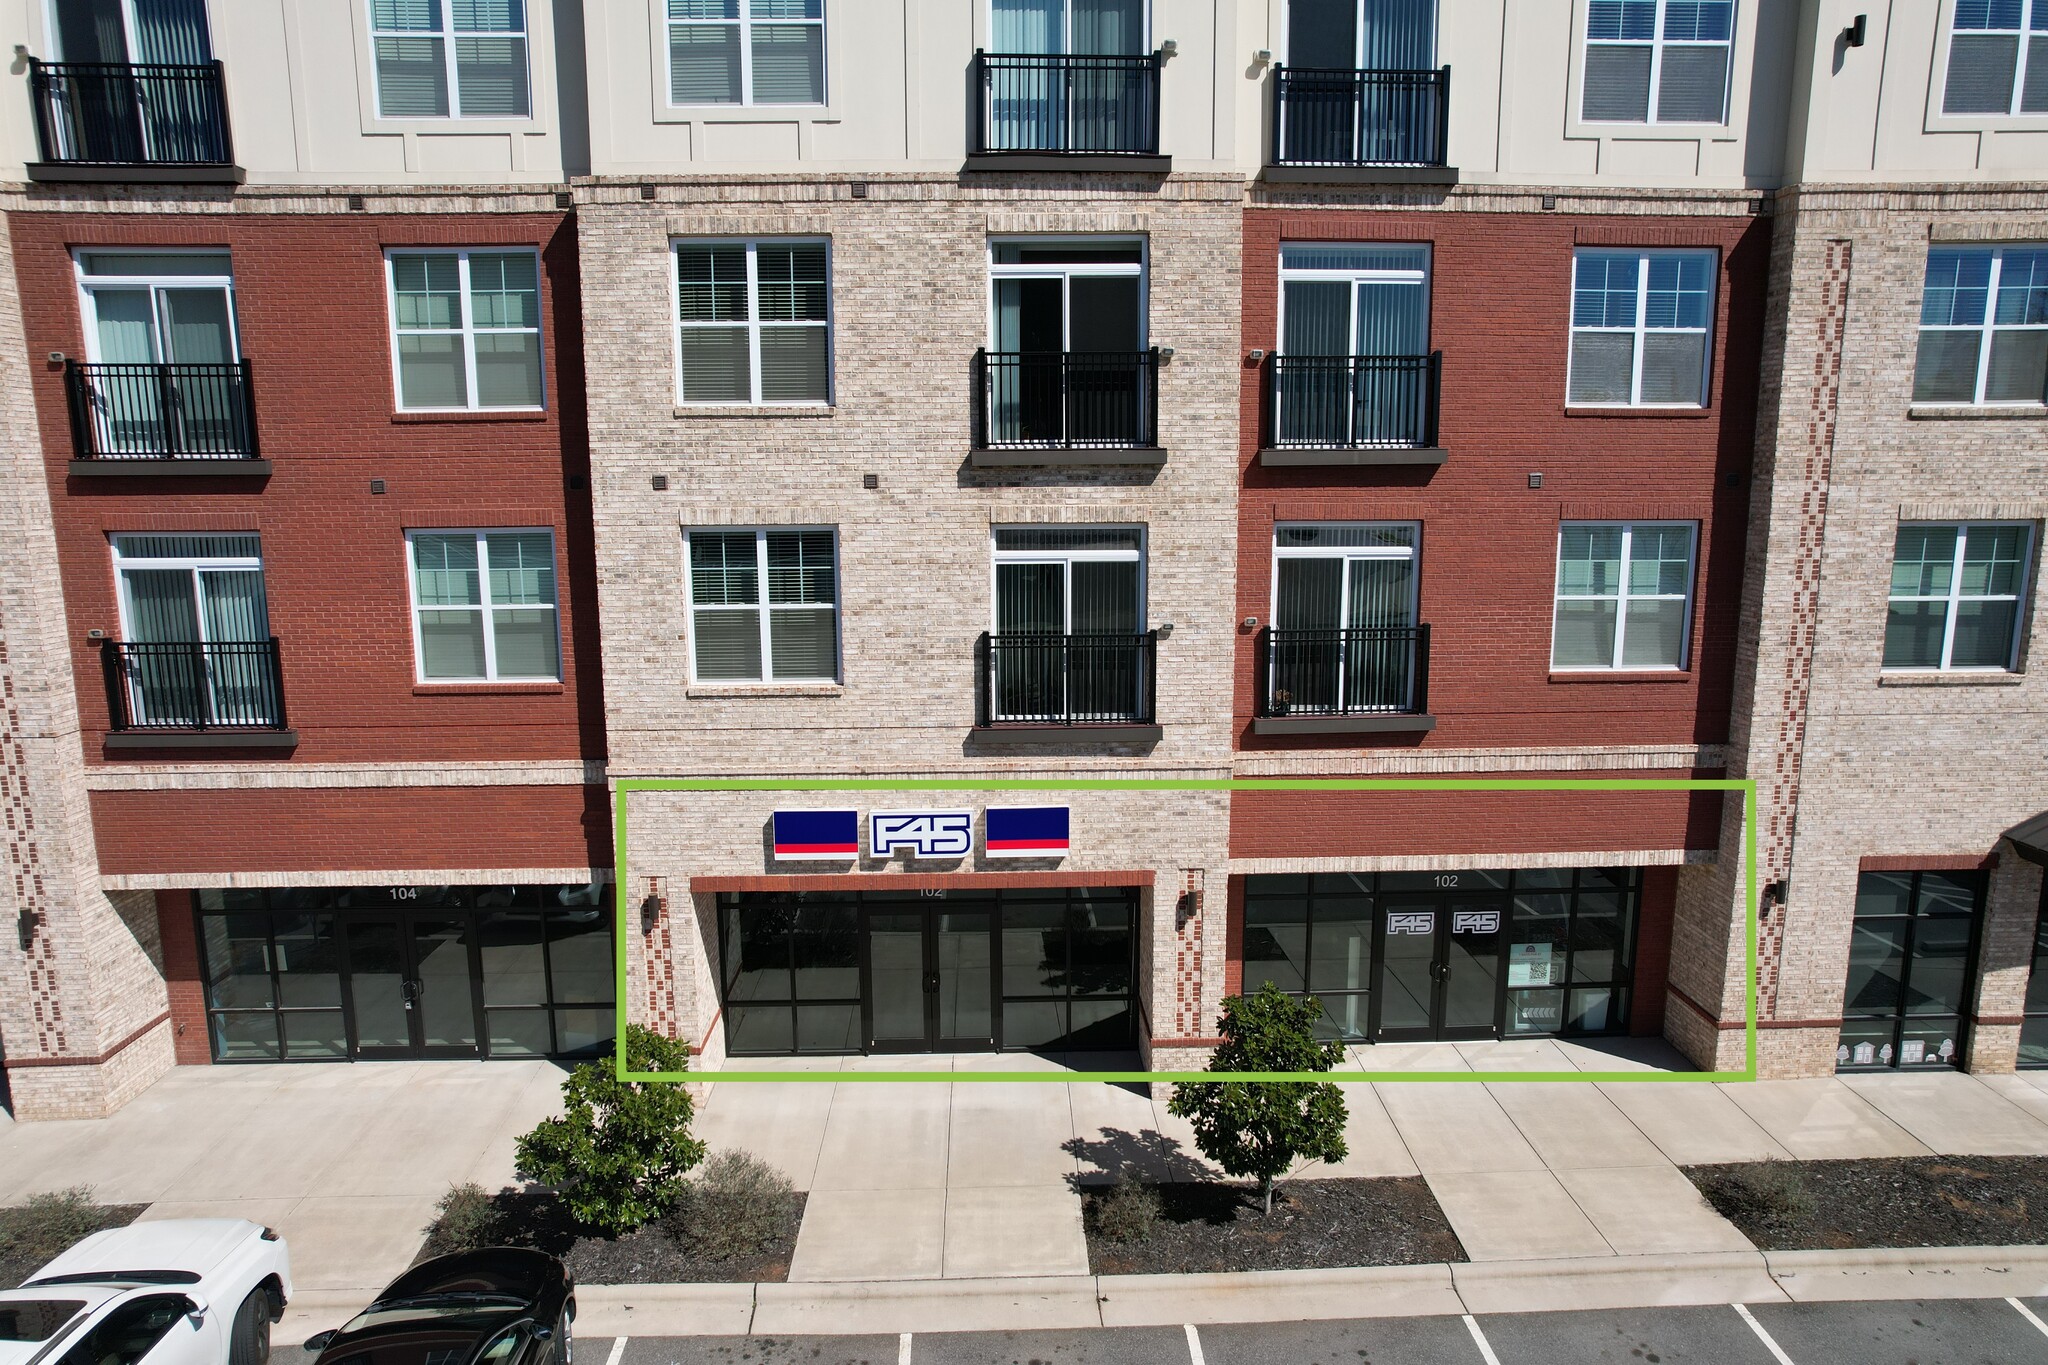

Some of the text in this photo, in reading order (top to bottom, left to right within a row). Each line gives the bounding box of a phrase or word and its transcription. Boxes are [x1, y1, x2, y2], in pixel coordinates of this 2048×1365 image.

[873, 814, 971, 856] F45
[1433, 875, 1458, 887] 102
[389, 887, 417, 900] 104
[1388, 912, 1434, 934] F45
[1454, 911, 1500, 933] F45
